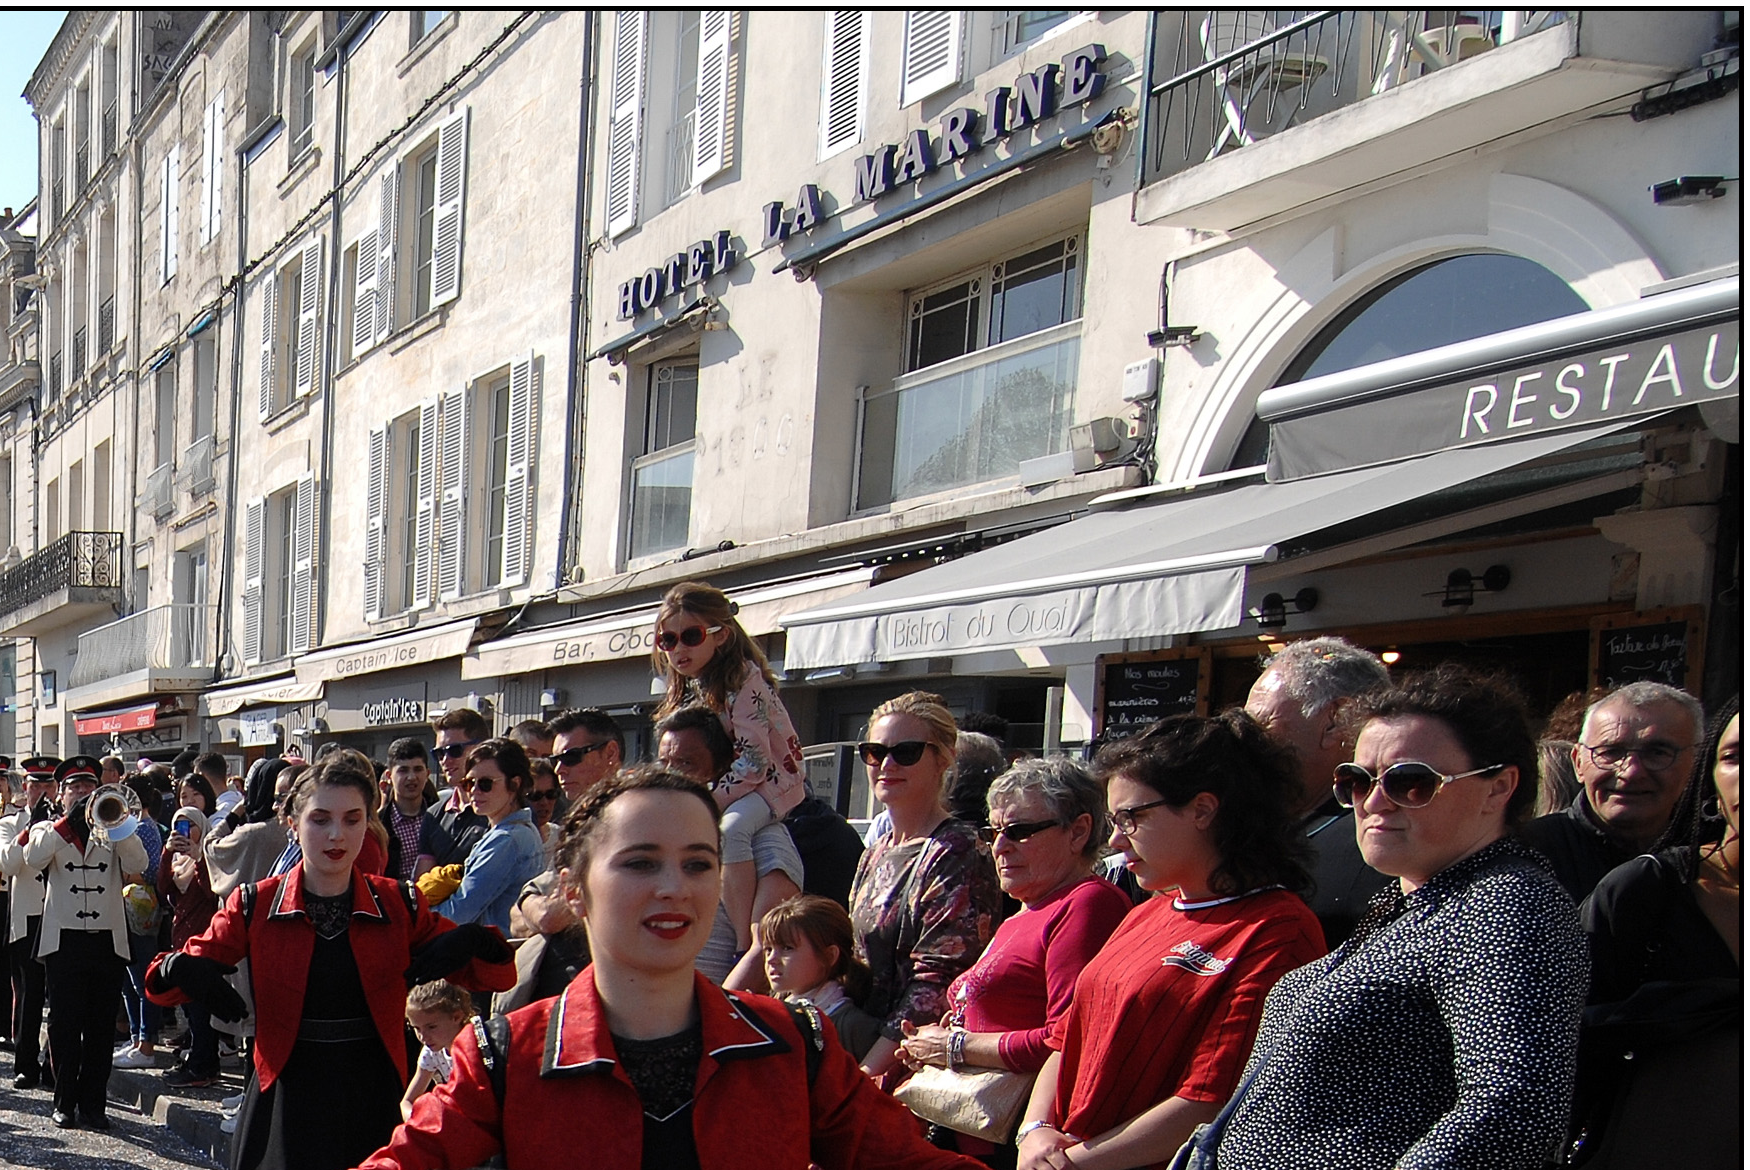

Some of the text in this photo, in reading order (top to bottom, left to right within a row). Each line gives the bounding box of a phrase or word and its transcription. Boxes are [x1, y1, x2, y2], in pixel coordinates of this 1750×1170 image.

[616, 44, 1107, 321] HOTEL LA MARINE
[1459, 334, 1739, 439] RESTAU
[893, 598, 1069, 648] Bistrot du Quai
[553, 641, 595, 660] Bar,
[1147, 665, 1180, 678] moules
[1170, 940, 1234, 973] Original
